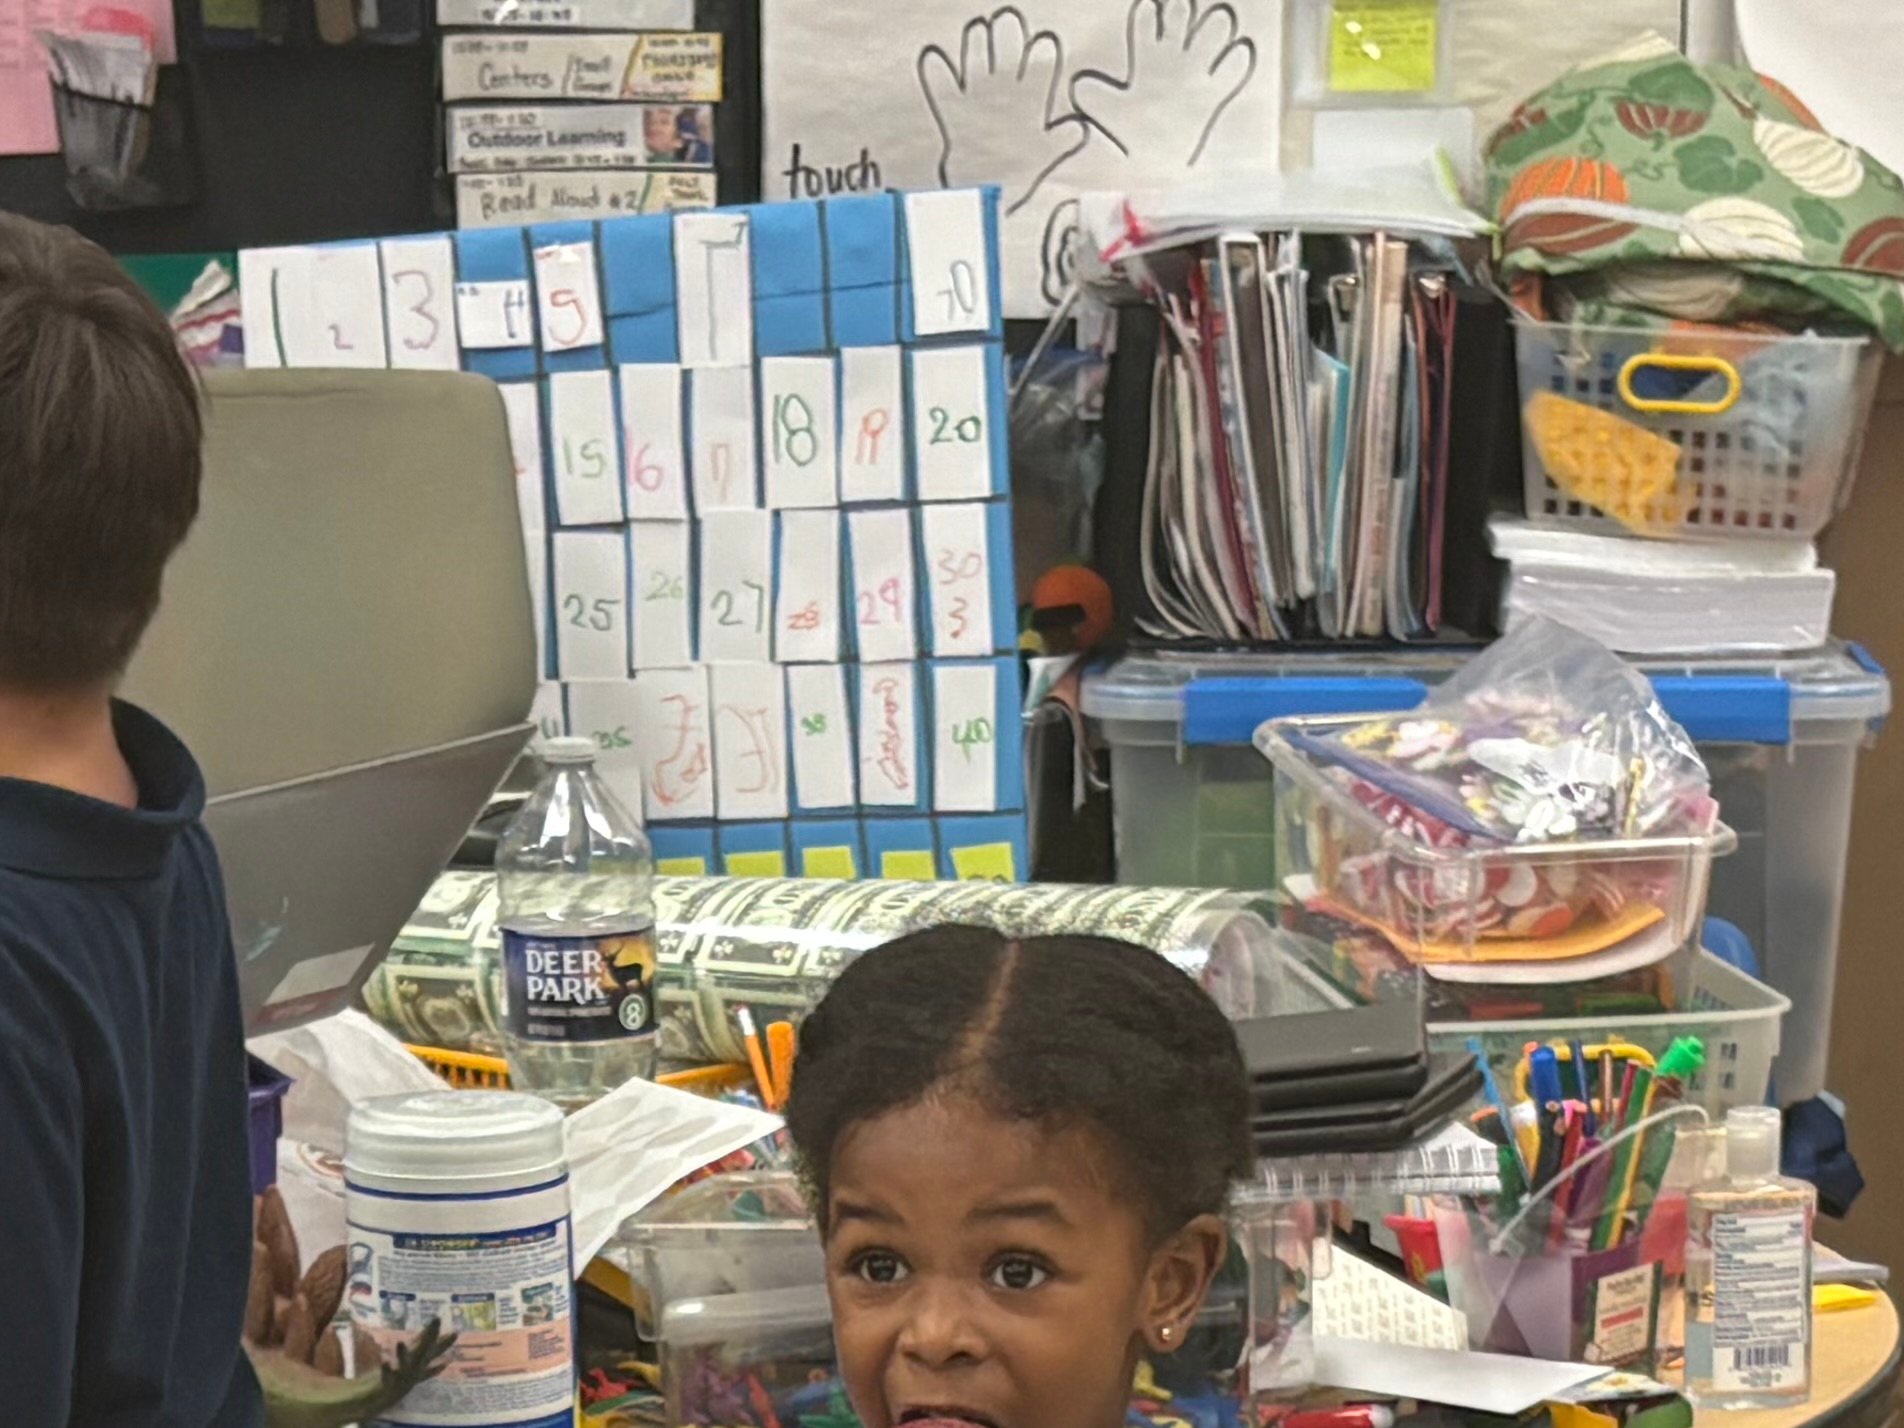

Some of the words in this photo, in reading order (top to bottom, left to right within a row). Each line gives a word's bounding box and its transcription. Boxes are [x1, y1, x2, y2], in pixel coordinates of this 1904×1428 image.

[478, 63, 552, 91] Centers
[467, 131, 543, 149] Outdoor
[546, 129, 627, 148] Learning
[782, 143, 881, 199] touch
[479, 183, 537, 220] Read
[270, 267, 288, 367] 1
[392, 269, 440, 350] 3
[328, 323, 354, 350] 2
[773, 393, 819, 467] 18
[929, 406, 983, 445] 20
[624, 424, 665, 492] 16
[645, 570, 684, 602] 26
[938, 550, 983, 586] 30
[562, 593, 622, 633] 25
[710, 579, 766, 634] 27
[858, 576, 904, 626] 29
[525, 949, 603, 975] DEER
[526, 974, 608, 1006] PARK
